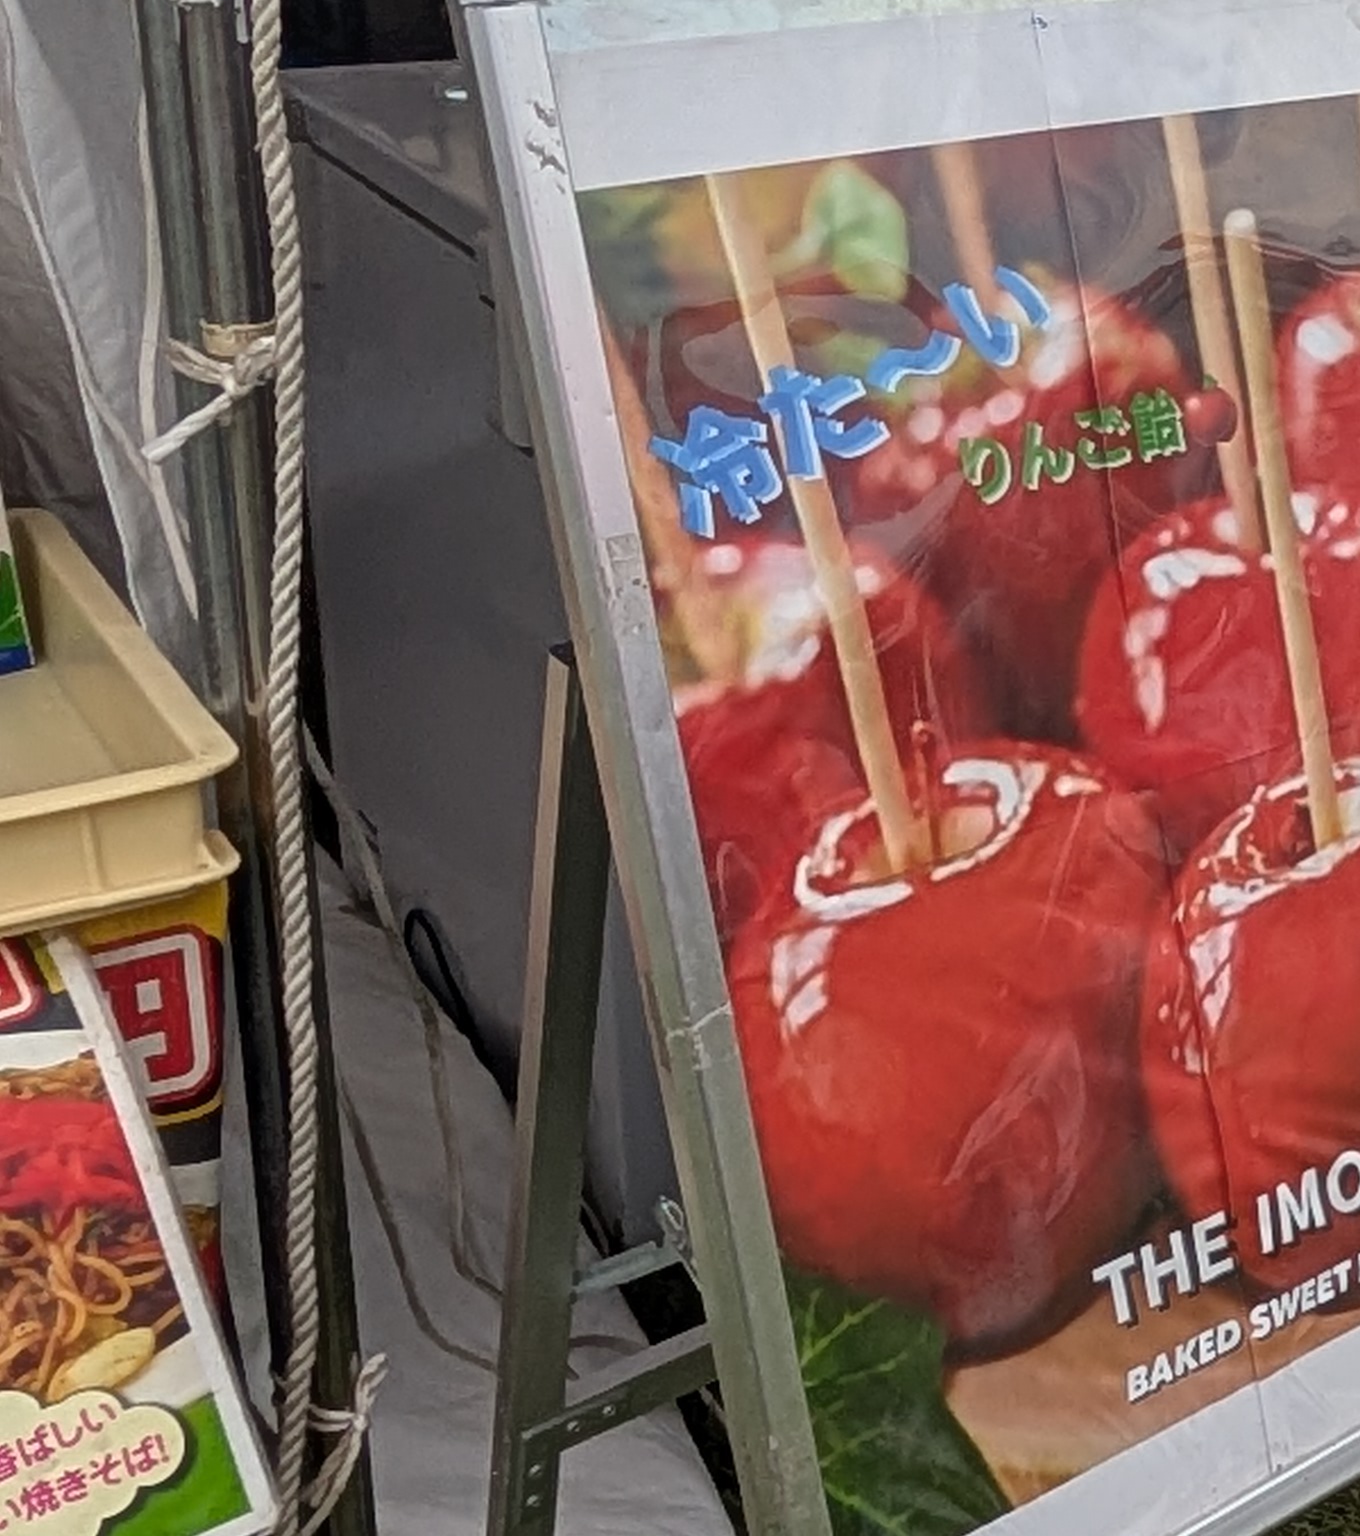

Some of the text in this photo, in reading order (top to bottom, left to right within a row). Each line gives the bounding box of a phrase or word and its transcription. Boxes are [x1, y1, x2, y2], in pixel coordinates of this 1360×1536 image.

[958, 387, 1187, 505] りんご飴
[1092, 1211, 1238, 1328] THE
[1126, 1318, 1245, 1404] BAKED
[1249, 1259, 1353, 1342] SWEET
